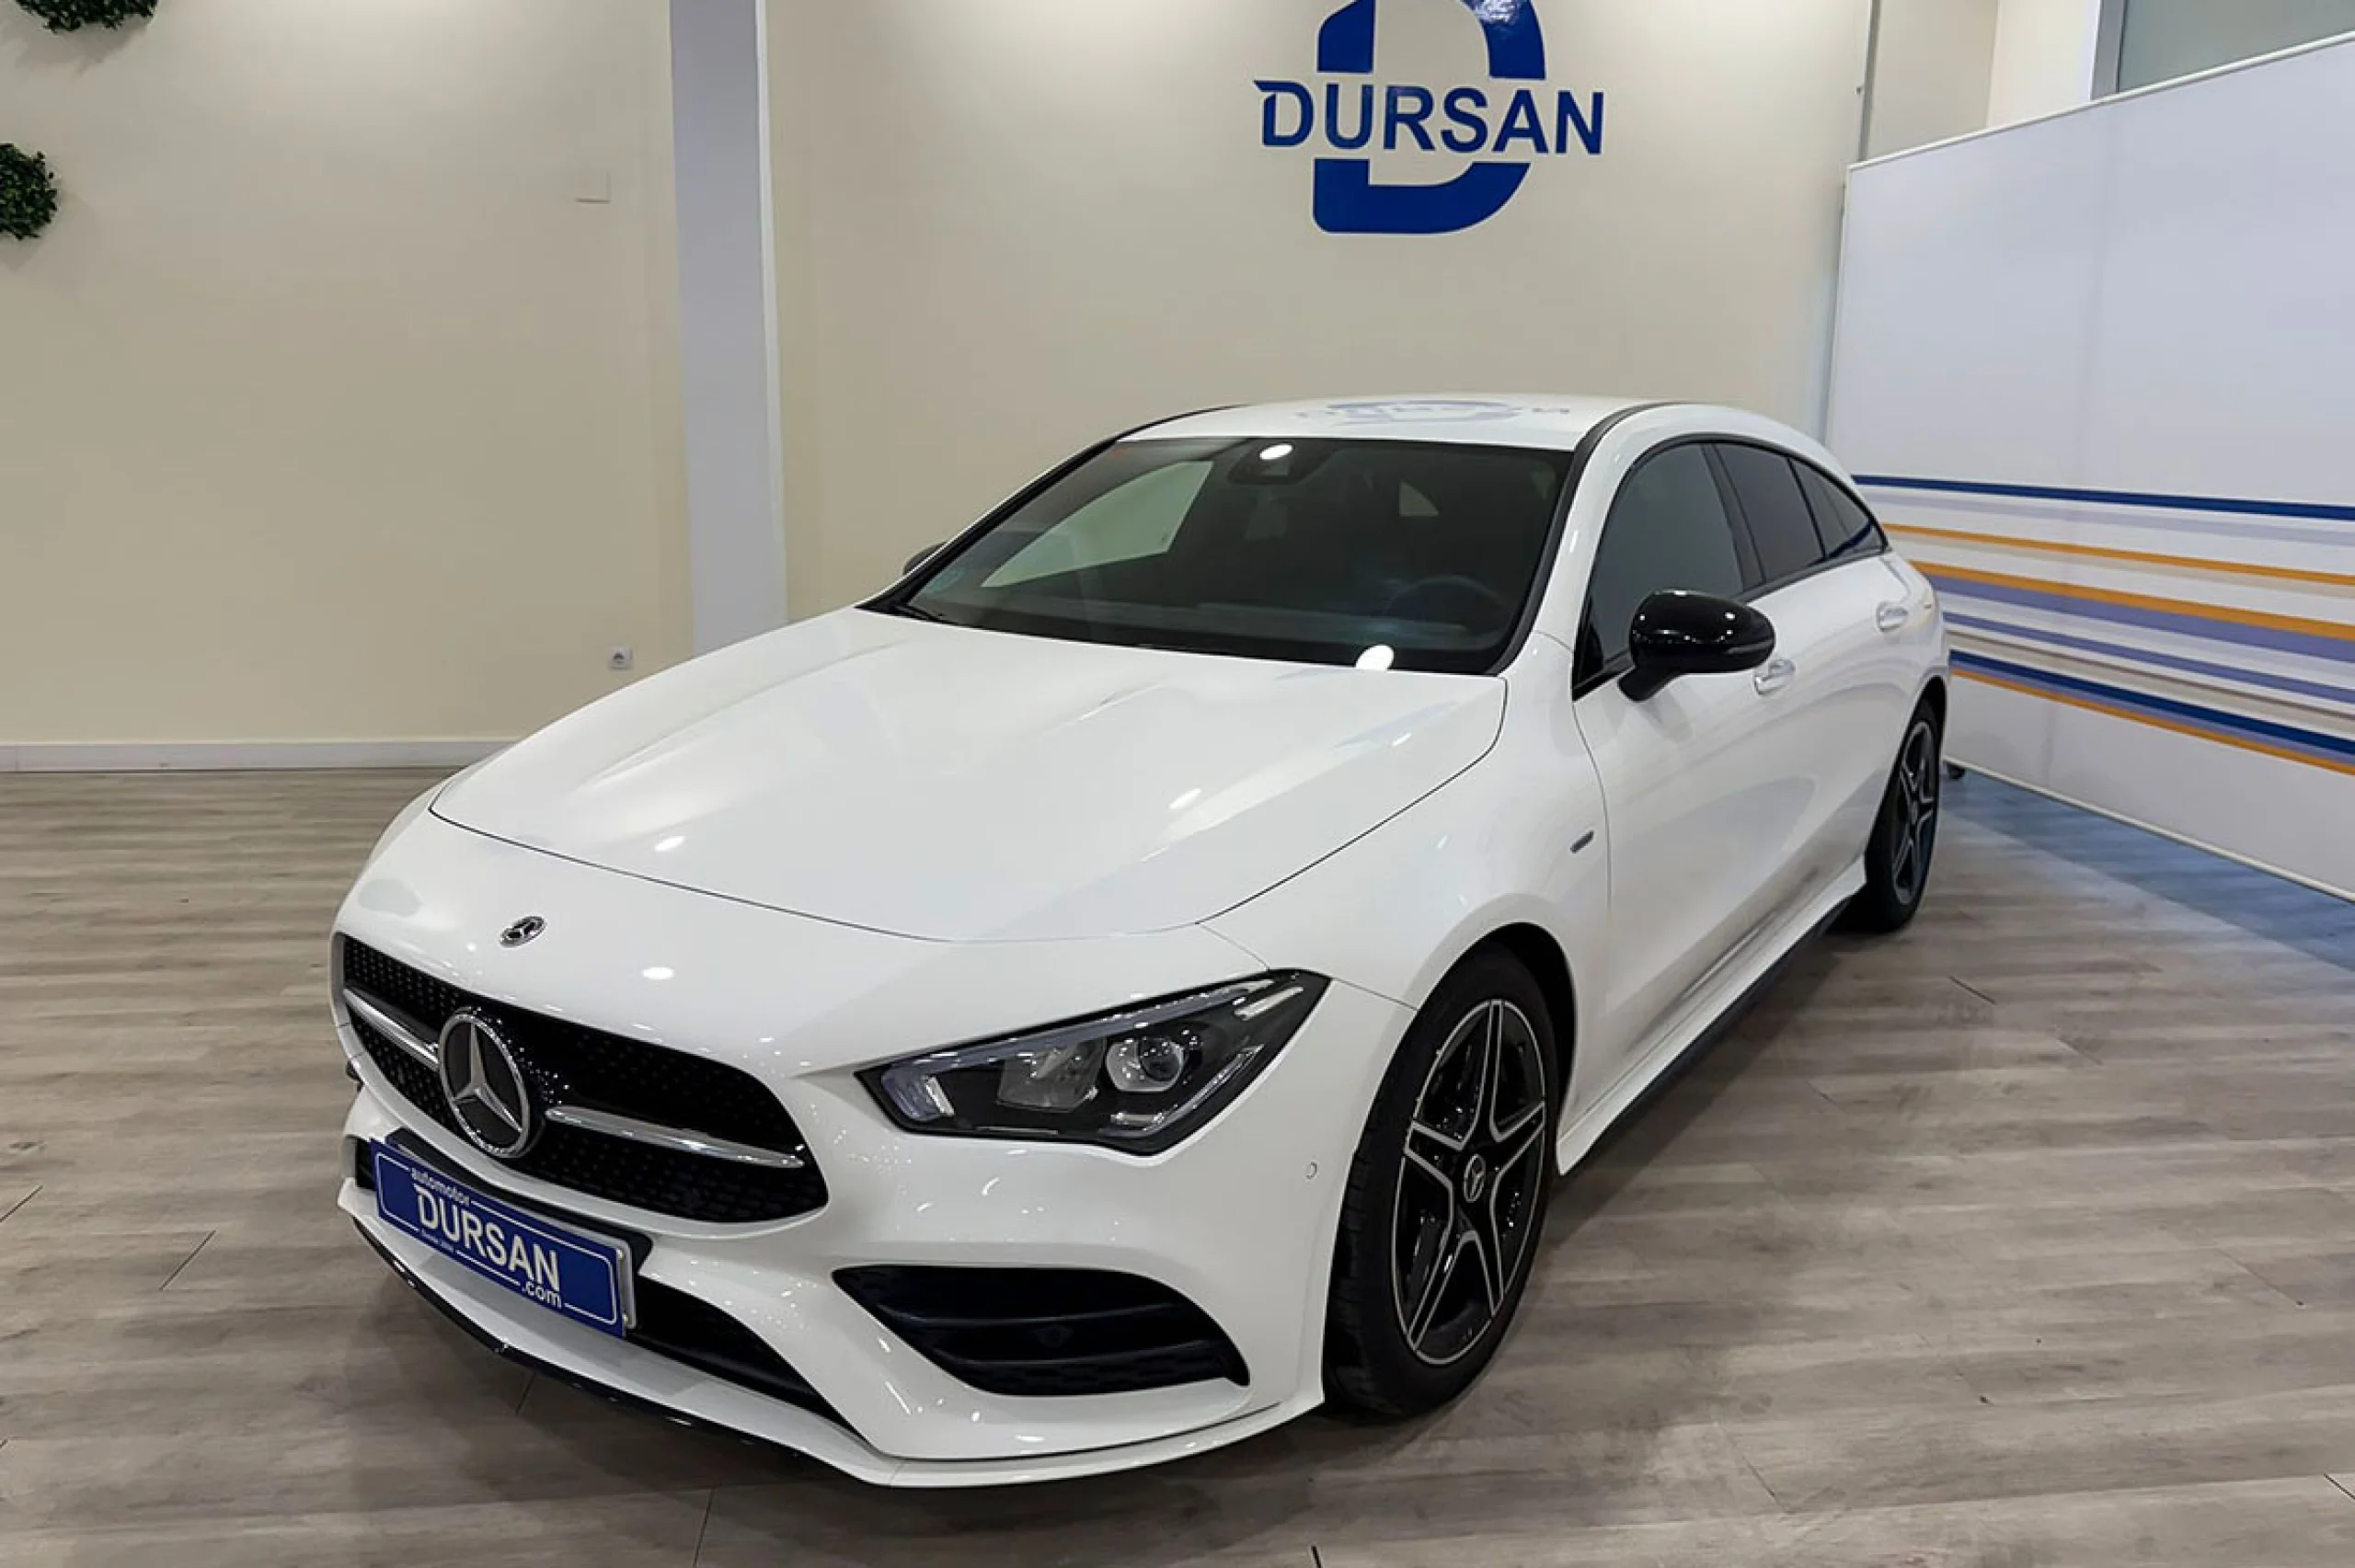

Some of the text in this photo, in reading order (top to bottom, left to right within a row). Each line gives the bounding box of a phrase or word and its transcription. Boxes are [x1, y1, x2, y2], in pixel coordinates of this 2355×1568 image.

[1254, 80, 1604, 155] DURSAN
[414, 1183, 560, 1292] DURSAN
[522, 1281, 562, 1309] .com
